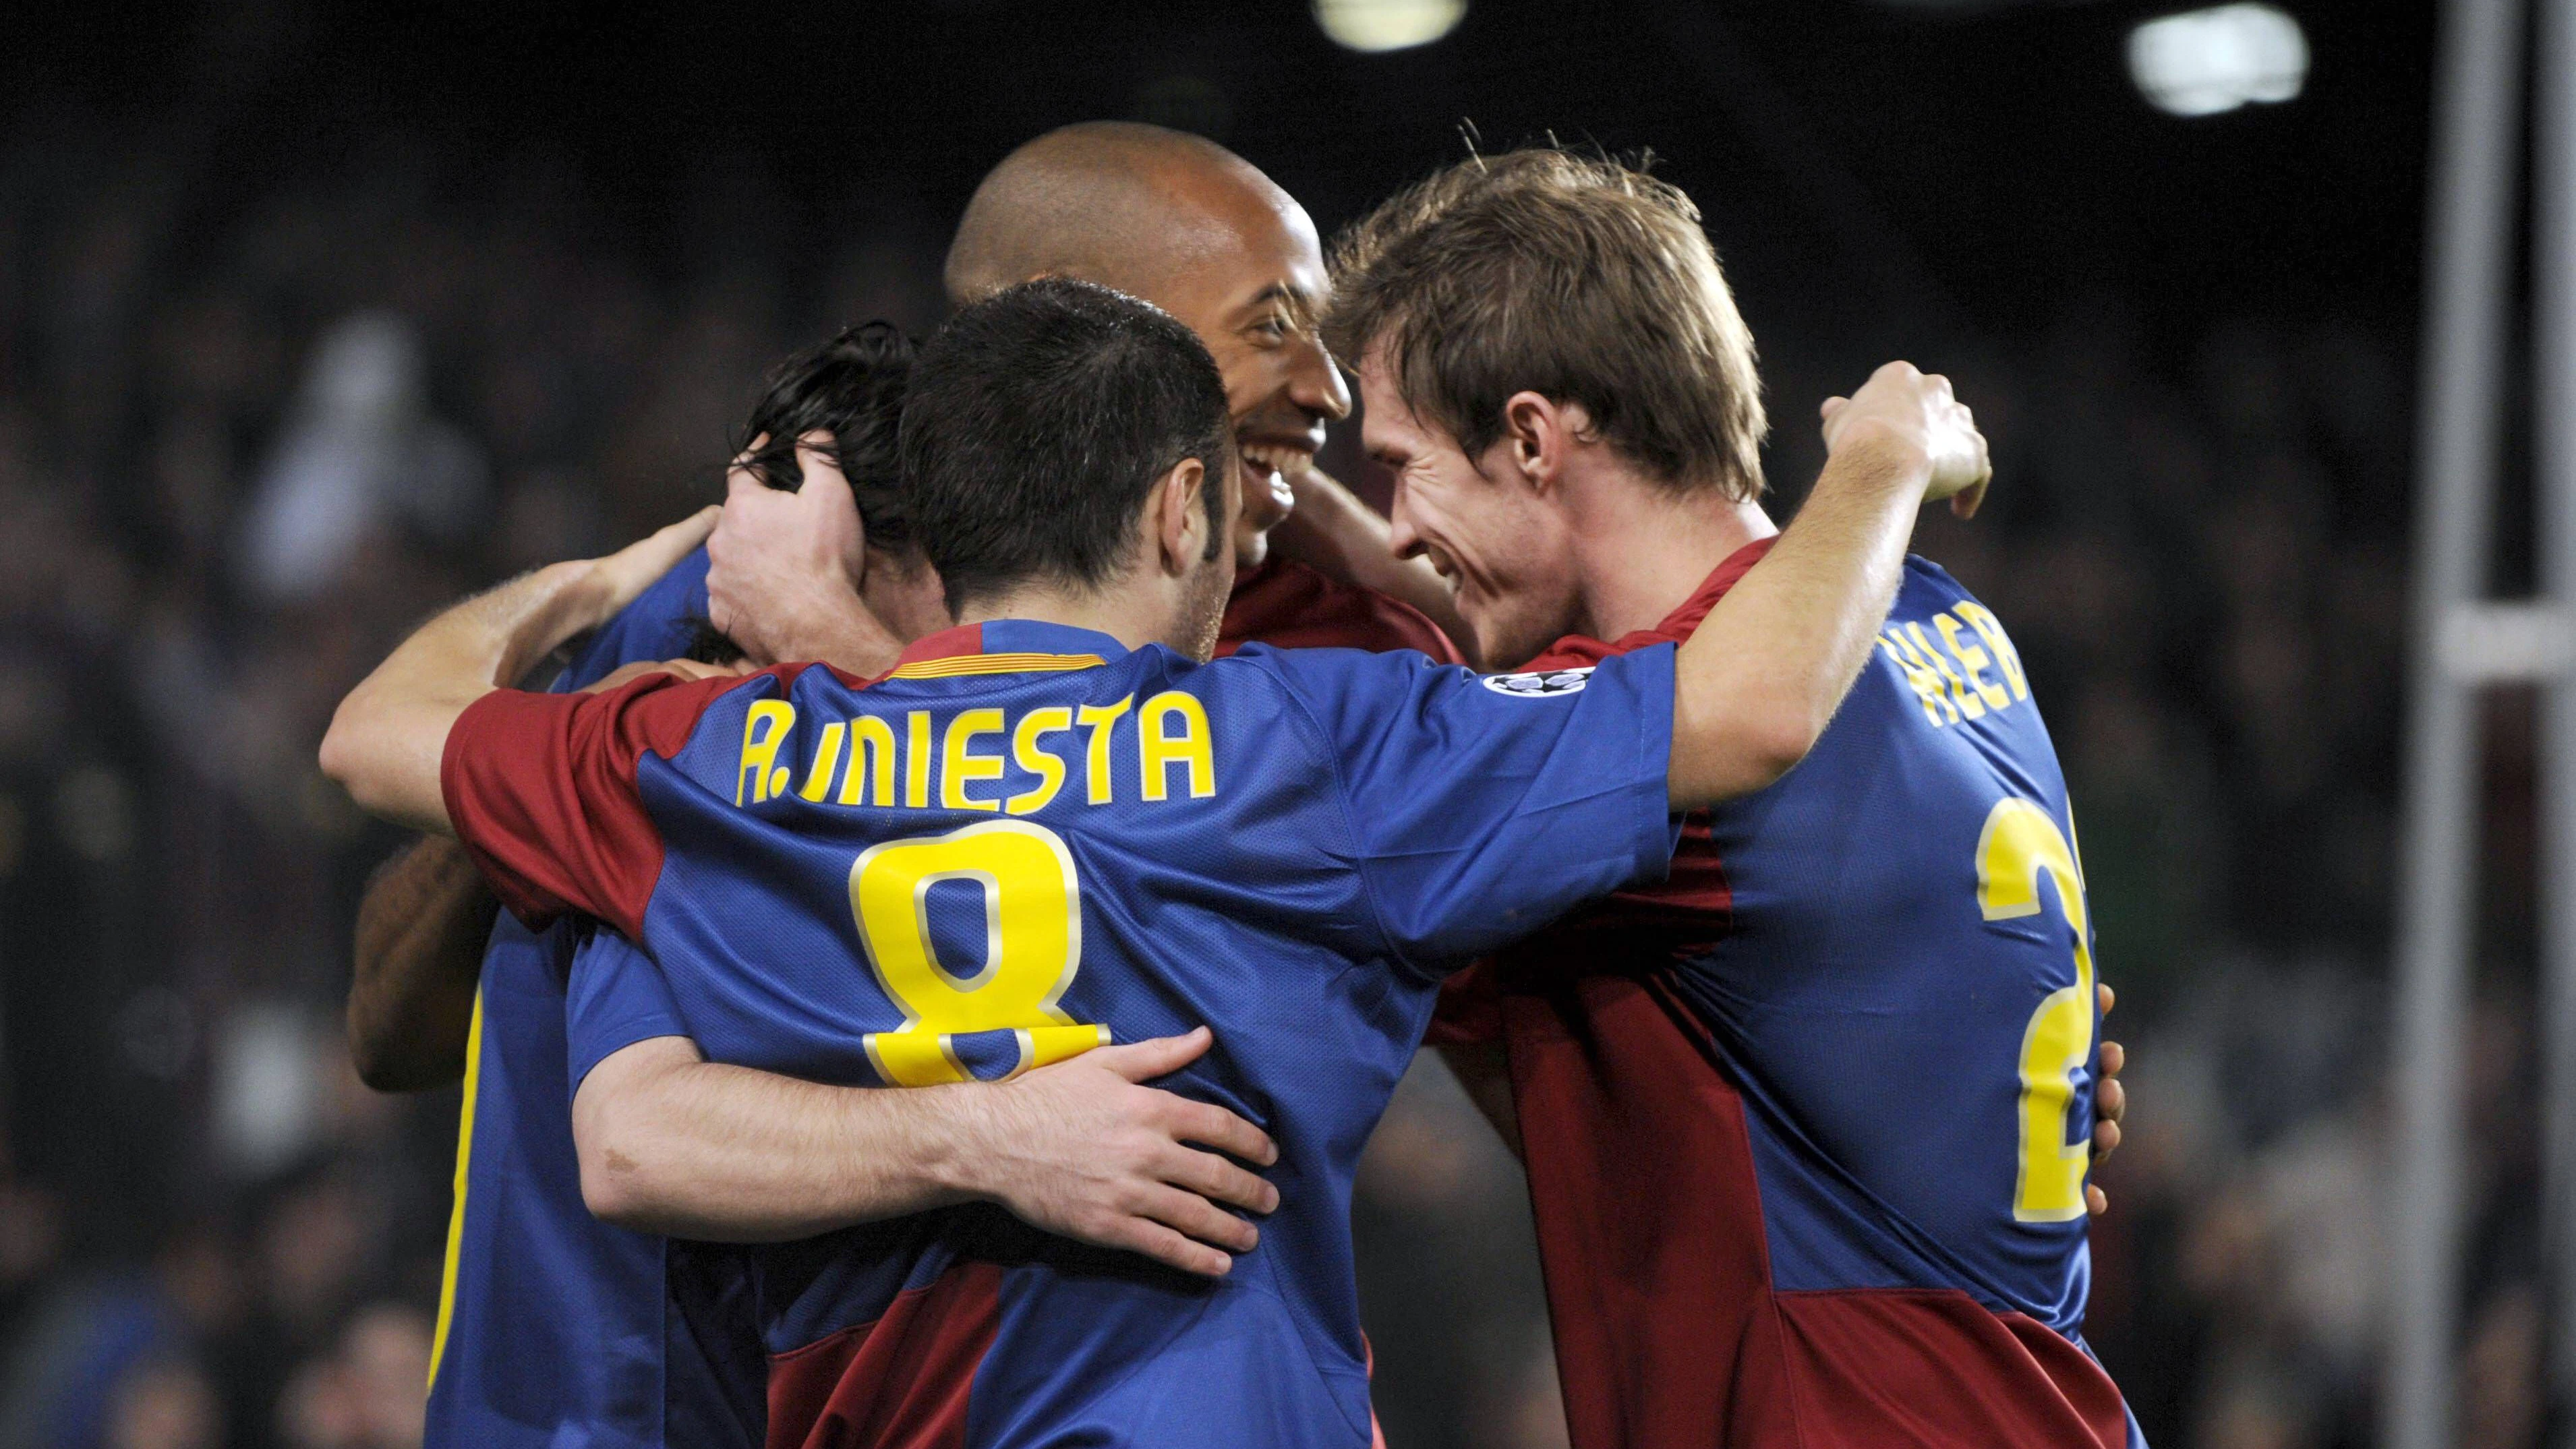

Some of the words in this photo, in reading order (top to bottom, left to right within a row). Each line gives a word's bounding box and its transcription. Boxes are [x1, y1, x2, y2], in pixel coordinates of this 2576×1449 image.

[736, 691, 1216, 815] A.INIESTA
[1877, 600, 2026, 727] HLEB
[848, 819, 1111, 1088] 8
[1975, 793, 2093, 1222] 2
